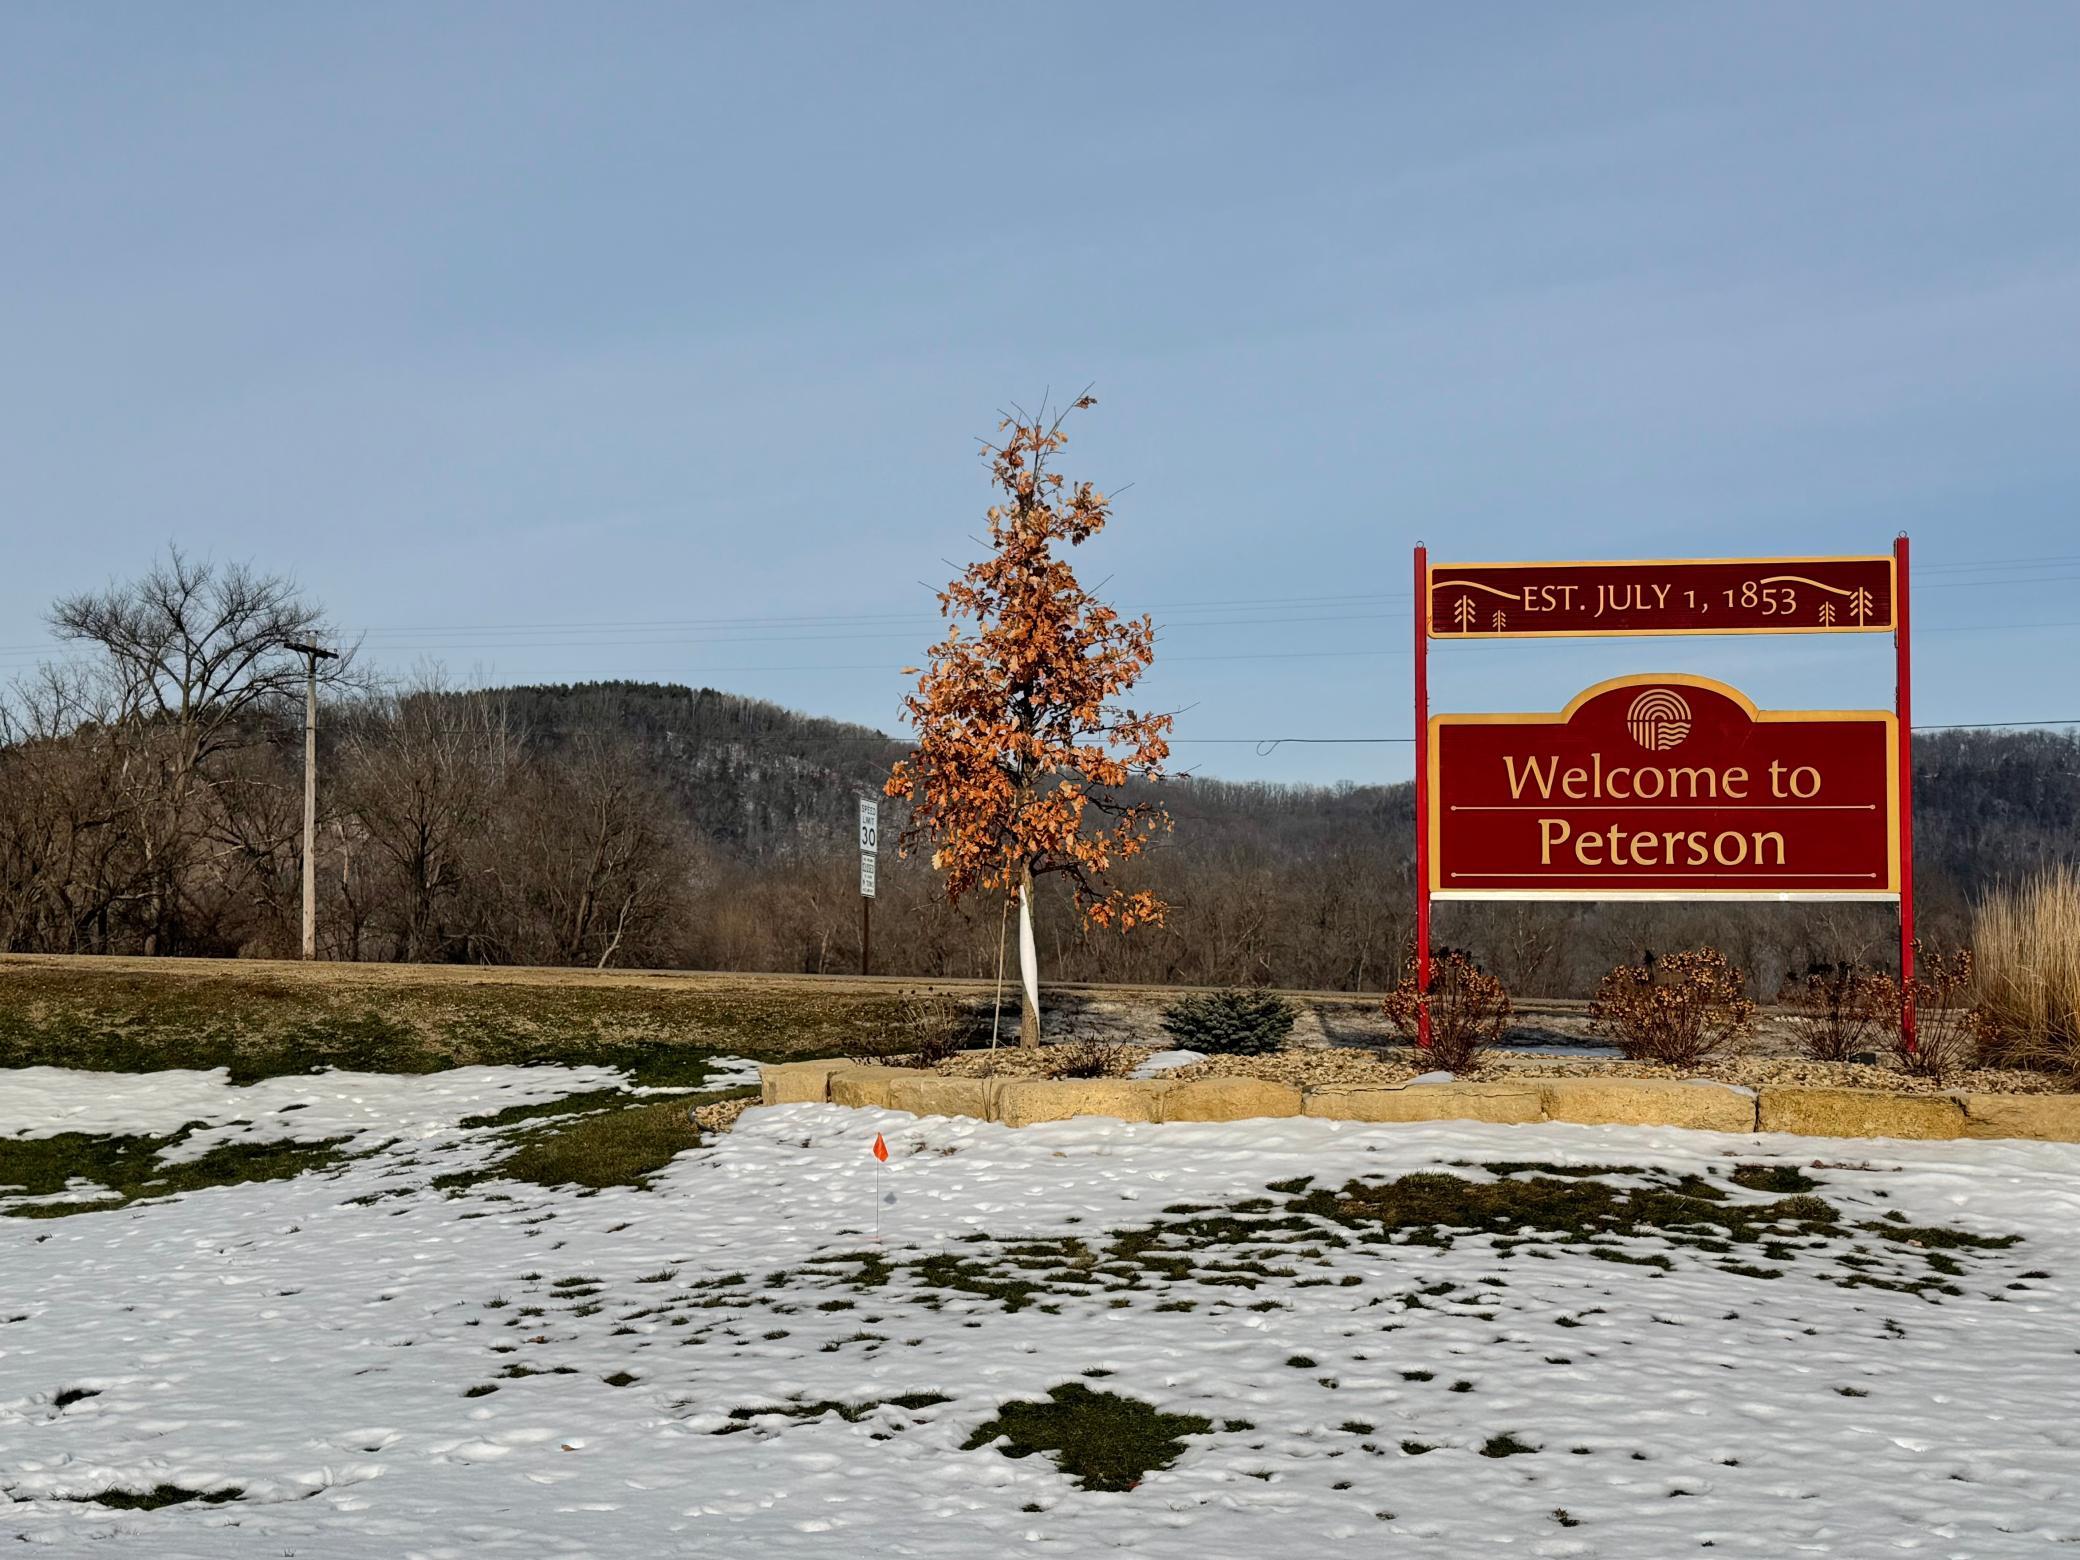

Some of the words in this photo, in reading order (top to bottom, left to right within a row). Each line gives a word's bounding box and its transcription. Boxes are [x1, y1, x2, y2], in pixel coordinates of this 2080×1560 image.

[1523, 585, 1585, 612] EST.
[1594, 584, 1671, 618] JULY
[1683, 590, 1708, 613] 1,
[1722, 581, 1797, 615] 1853
[1502, 753, 1749, 799] Welcome
[1768, 760, 1821, 799] to
[862, 804, 876, 816] SPEED
[862, 816, 875, 826] LIMIT
[862, 826, 875, 846] 30
[1538, 819, 1785, 866] Peterson
